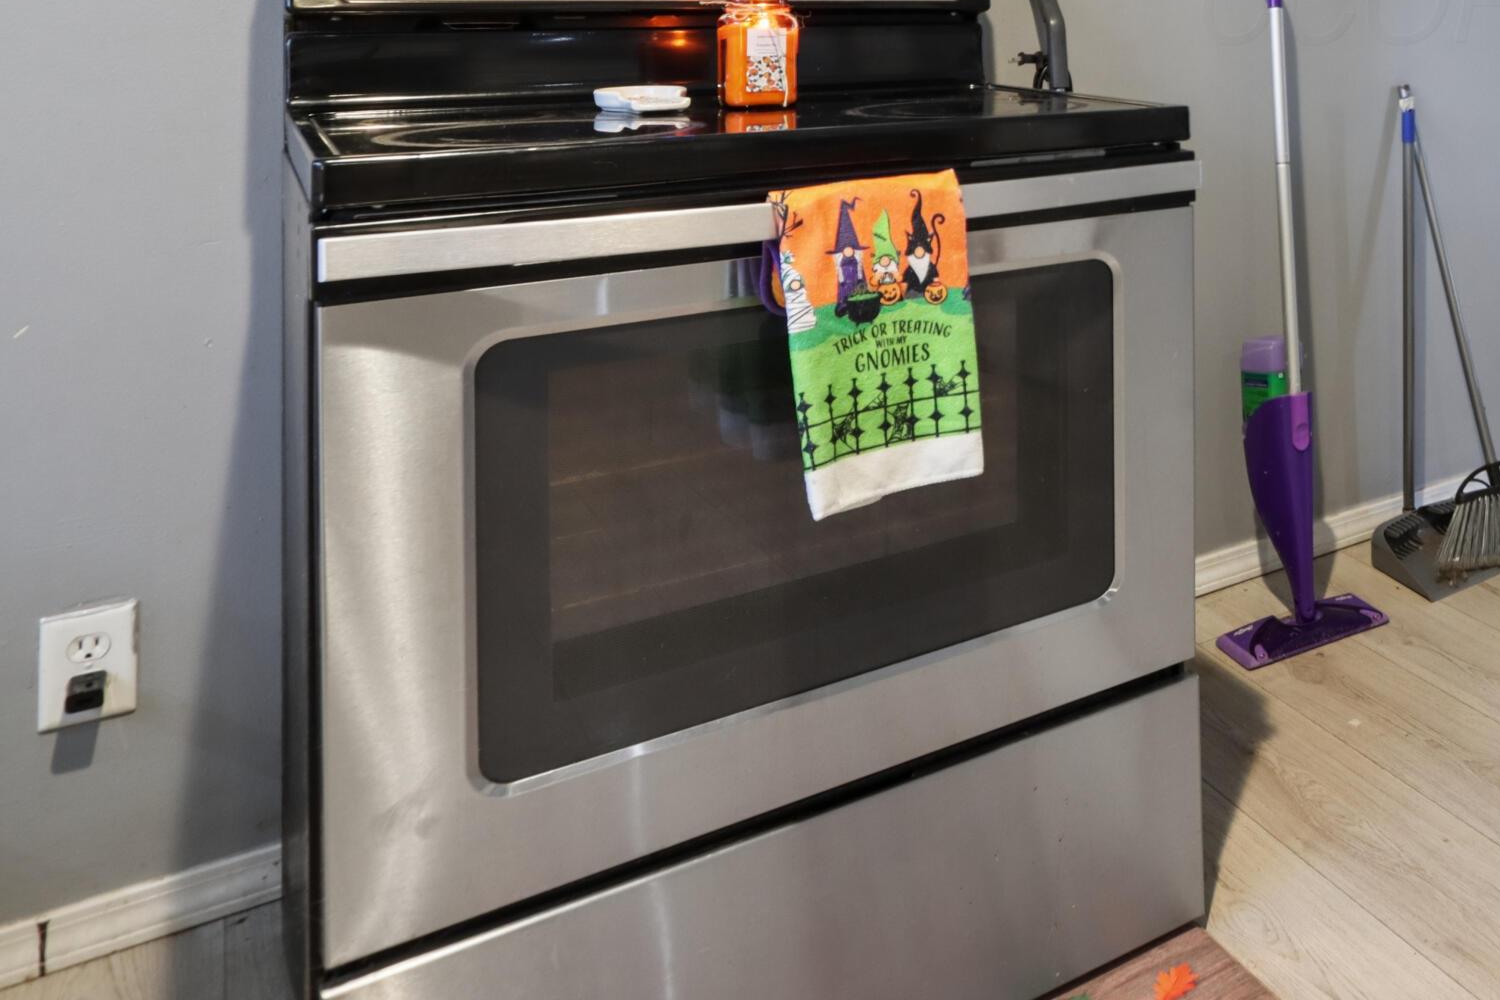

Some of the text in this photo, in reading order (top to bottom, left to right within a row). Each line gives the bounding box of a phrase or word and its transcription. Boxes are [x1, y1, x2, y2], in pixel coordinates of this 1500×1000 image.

[832, 319, 953, 355] TRICK OR TREATING
[875, 335, 908, 348] WITH MY
[855, 342, 931, 373] GNOMIES
